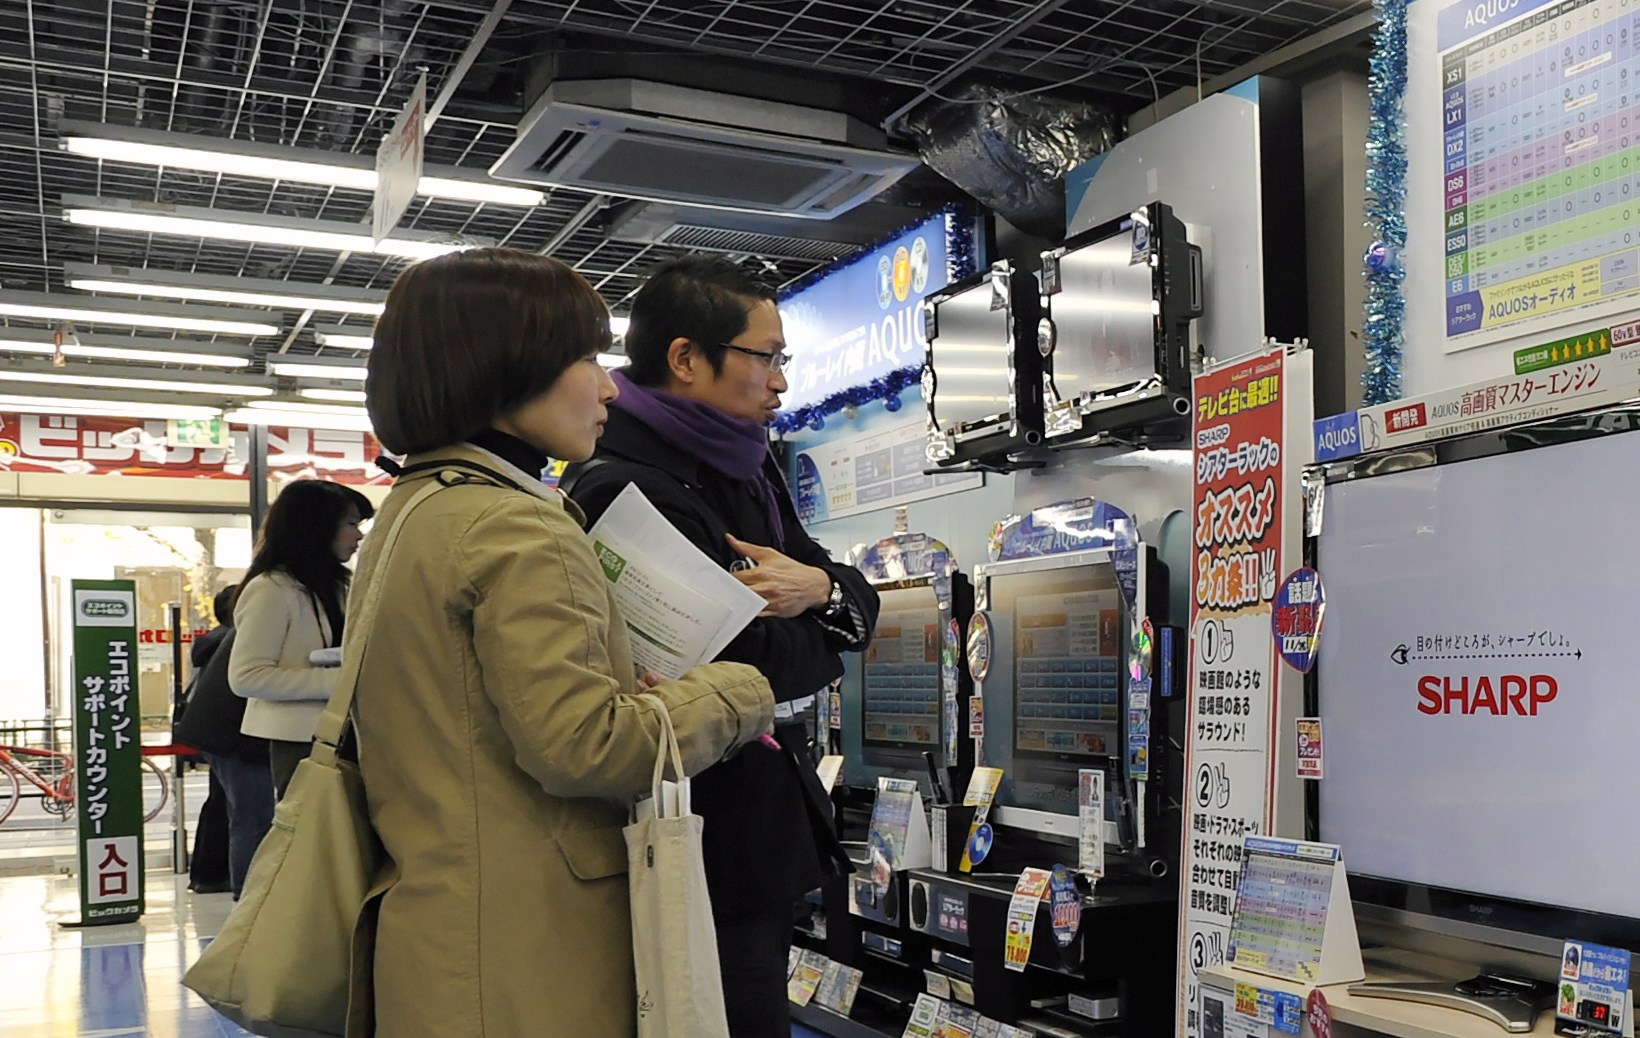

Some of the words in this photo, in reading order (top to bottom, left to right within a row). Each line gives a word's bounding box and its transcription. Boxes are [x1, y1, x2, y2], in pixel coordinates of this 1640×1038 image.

[1447, 68, 1462, 84] XS1
[1447, 108, 1462, 125] LX1
[1447, 140, 1464, 155] DX2
[1447, 175, 1464, 193] DS6
[1452, 280, 1463, 293] E6
[1488, 282, 1577, 320] AQUOSオーディオ
[1198, 375, 1279, 423] テレビ台に最適!!
[1431, 401, 1460, 419] AQUOS
[1460, 362, 1601, 417] 高画質マスターエンジン
[1391, 406, 1421, 430] 新開発
[1198, 427, 1229, 445] SHARP
[1318, 427, 1357, 452] AQUOS
[1197, 439, 1278, 484] シアターラックの
[1196, 482, 1275, 548] オススメ
[1416, 631, 1570, 652] 目の付けどころが、シャープでしょ。
[1199, 669, 1261, 690] 映画館のような
[108, 641, 131, 750] エコポイント
[1198, 695, 1251, 717] 臨場感のある
[1417, 674, 1558, 716] SHARP
[1197, 721, 1246, 743] サラウンド!
[83, 676, 109, 834] サポートカウンター
[99, 843, 129, 896] 入口
